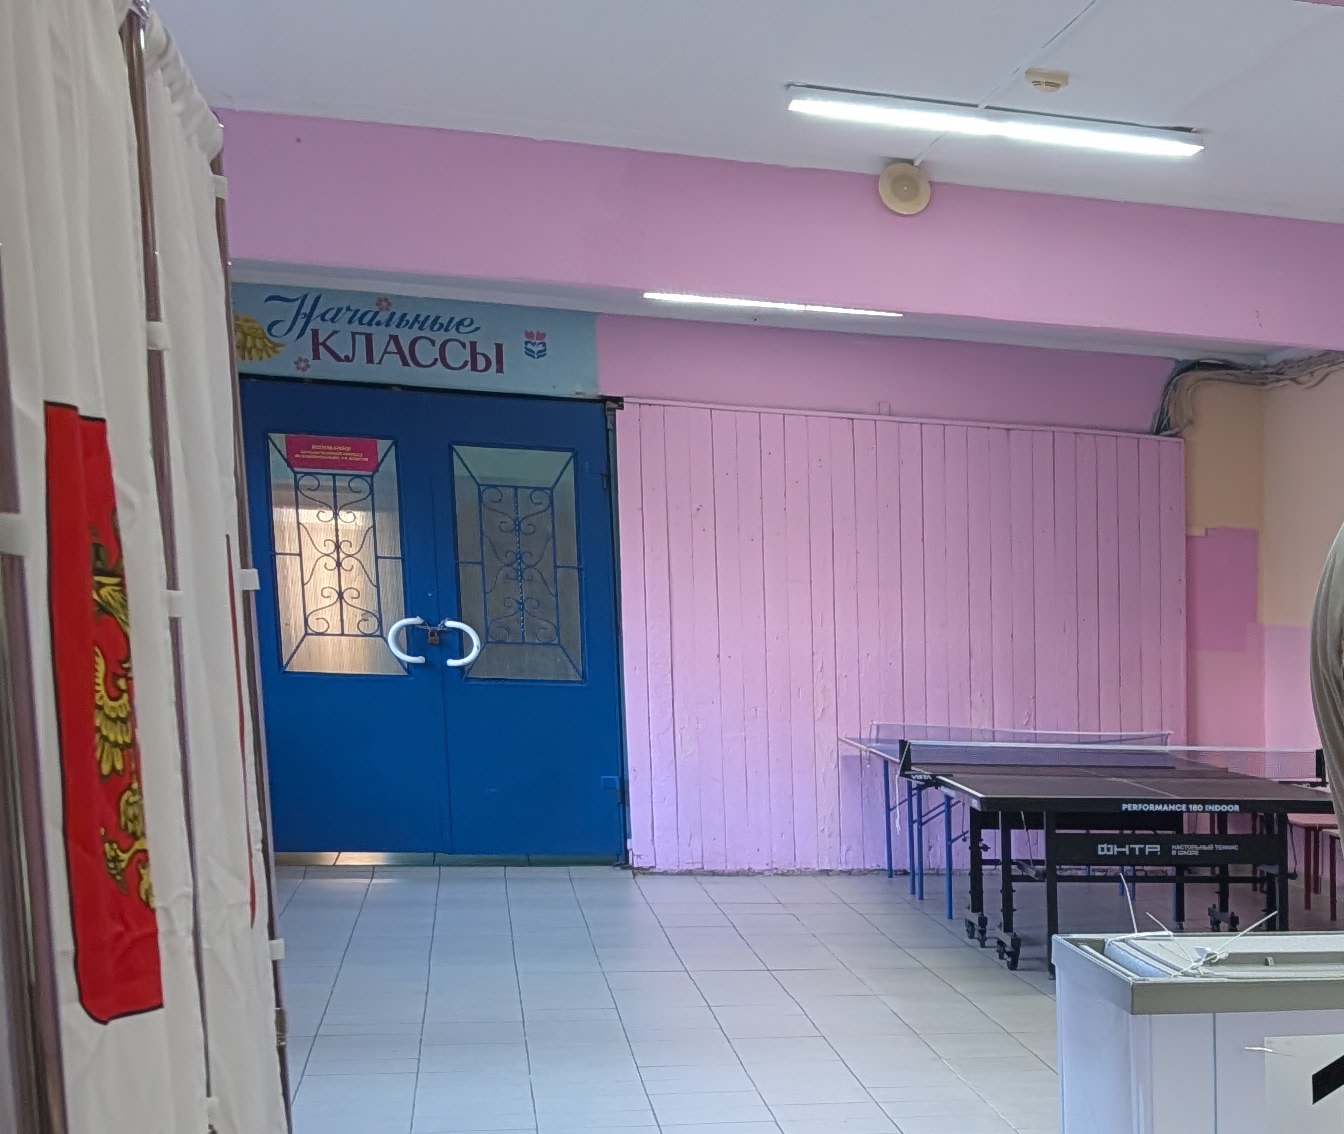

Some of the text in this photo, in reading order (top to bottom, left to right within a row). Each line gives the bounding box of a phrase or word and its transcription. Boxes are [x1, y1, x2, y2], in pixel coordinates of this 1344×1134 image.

[265, 292, 481, 341] Начальные
[310, 328, 505, 374] КЛАССЫ
[1121, 803, 1187, 812] PERFORMANCE
[1205, 804, 1240, 812] INDOOR
